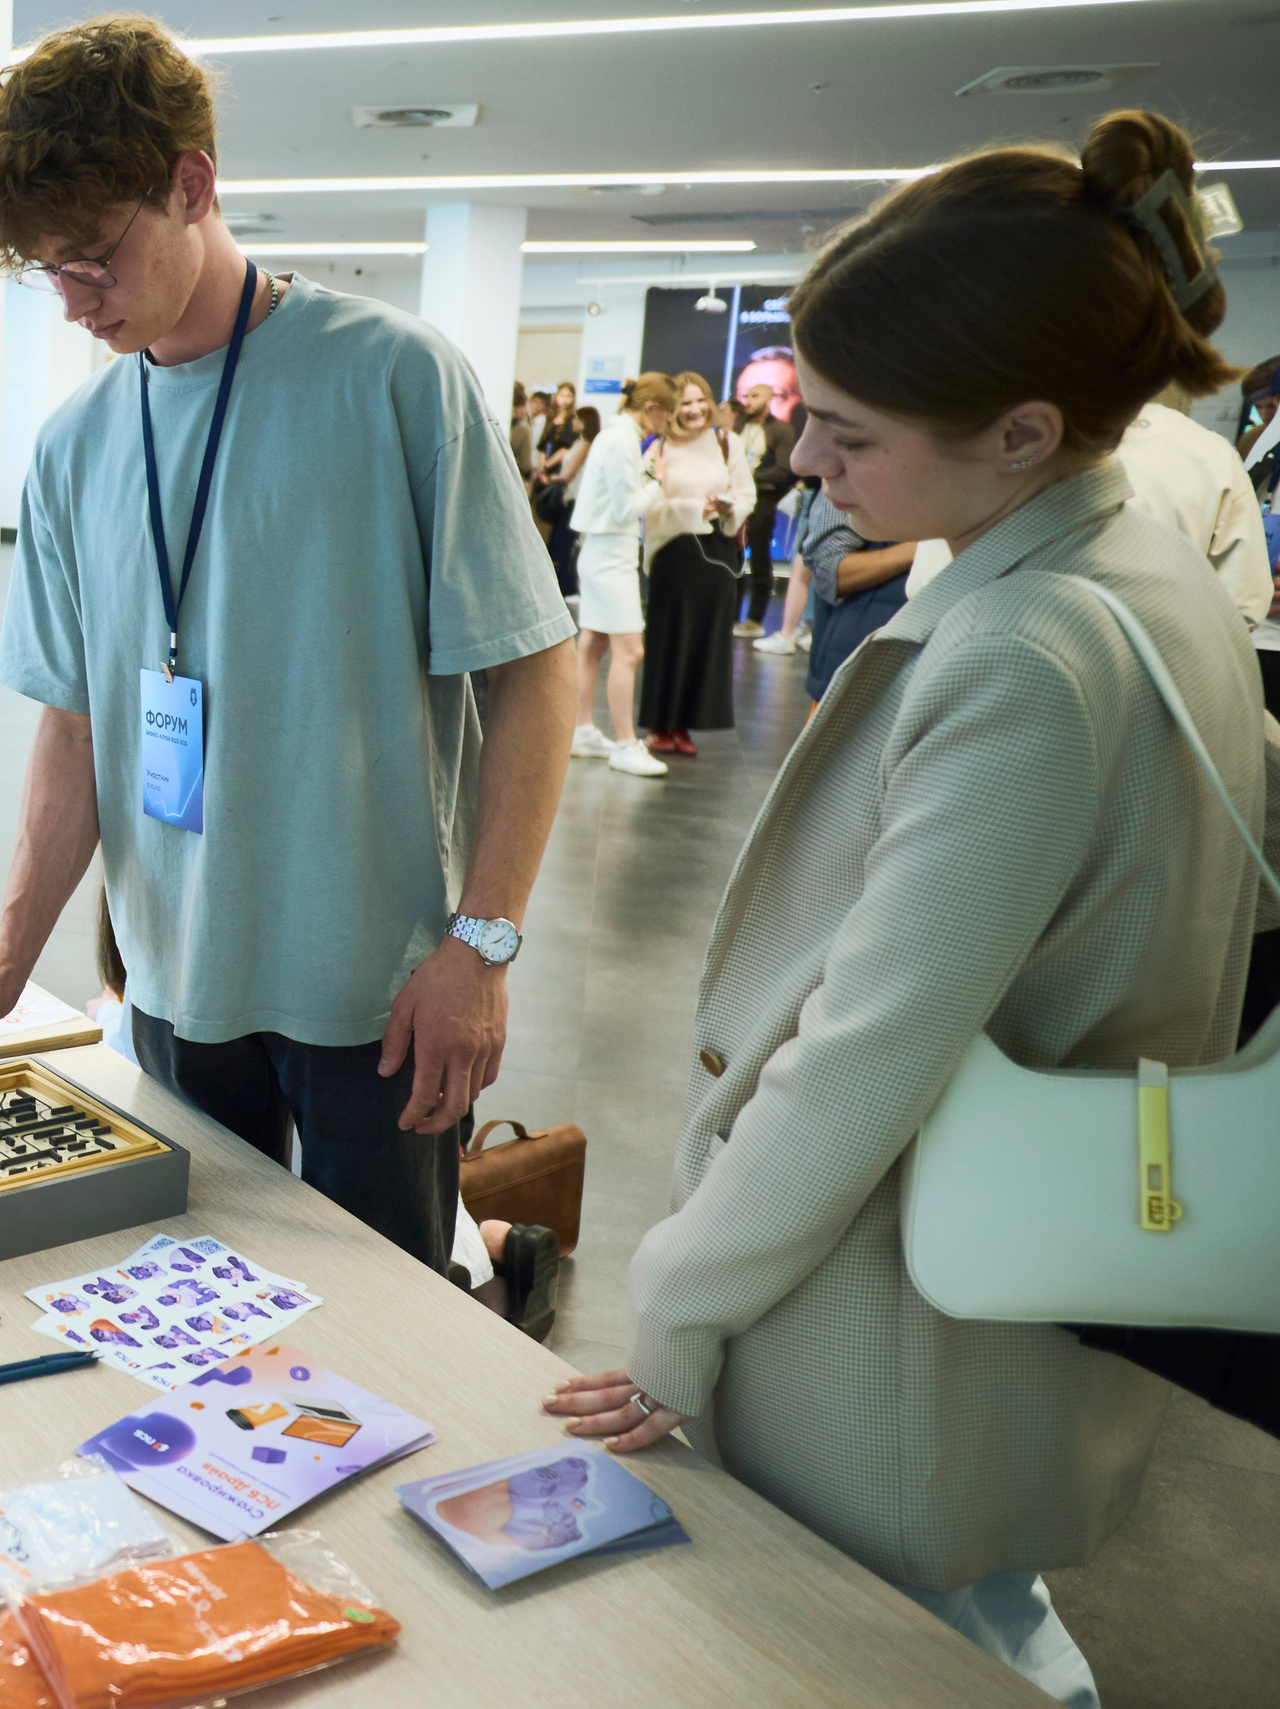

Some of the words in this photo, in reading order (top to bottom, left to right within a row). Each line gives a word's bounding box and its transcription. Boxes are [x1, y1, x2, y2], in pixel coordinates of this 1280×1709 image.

[145, 709, 188, 735] ФОРУМ
[202, 1462, 247, 1490] Драйв
[176, 1465, 264, 1520] Стажировка
[246, 1489, 282, 1511] ПСБ
